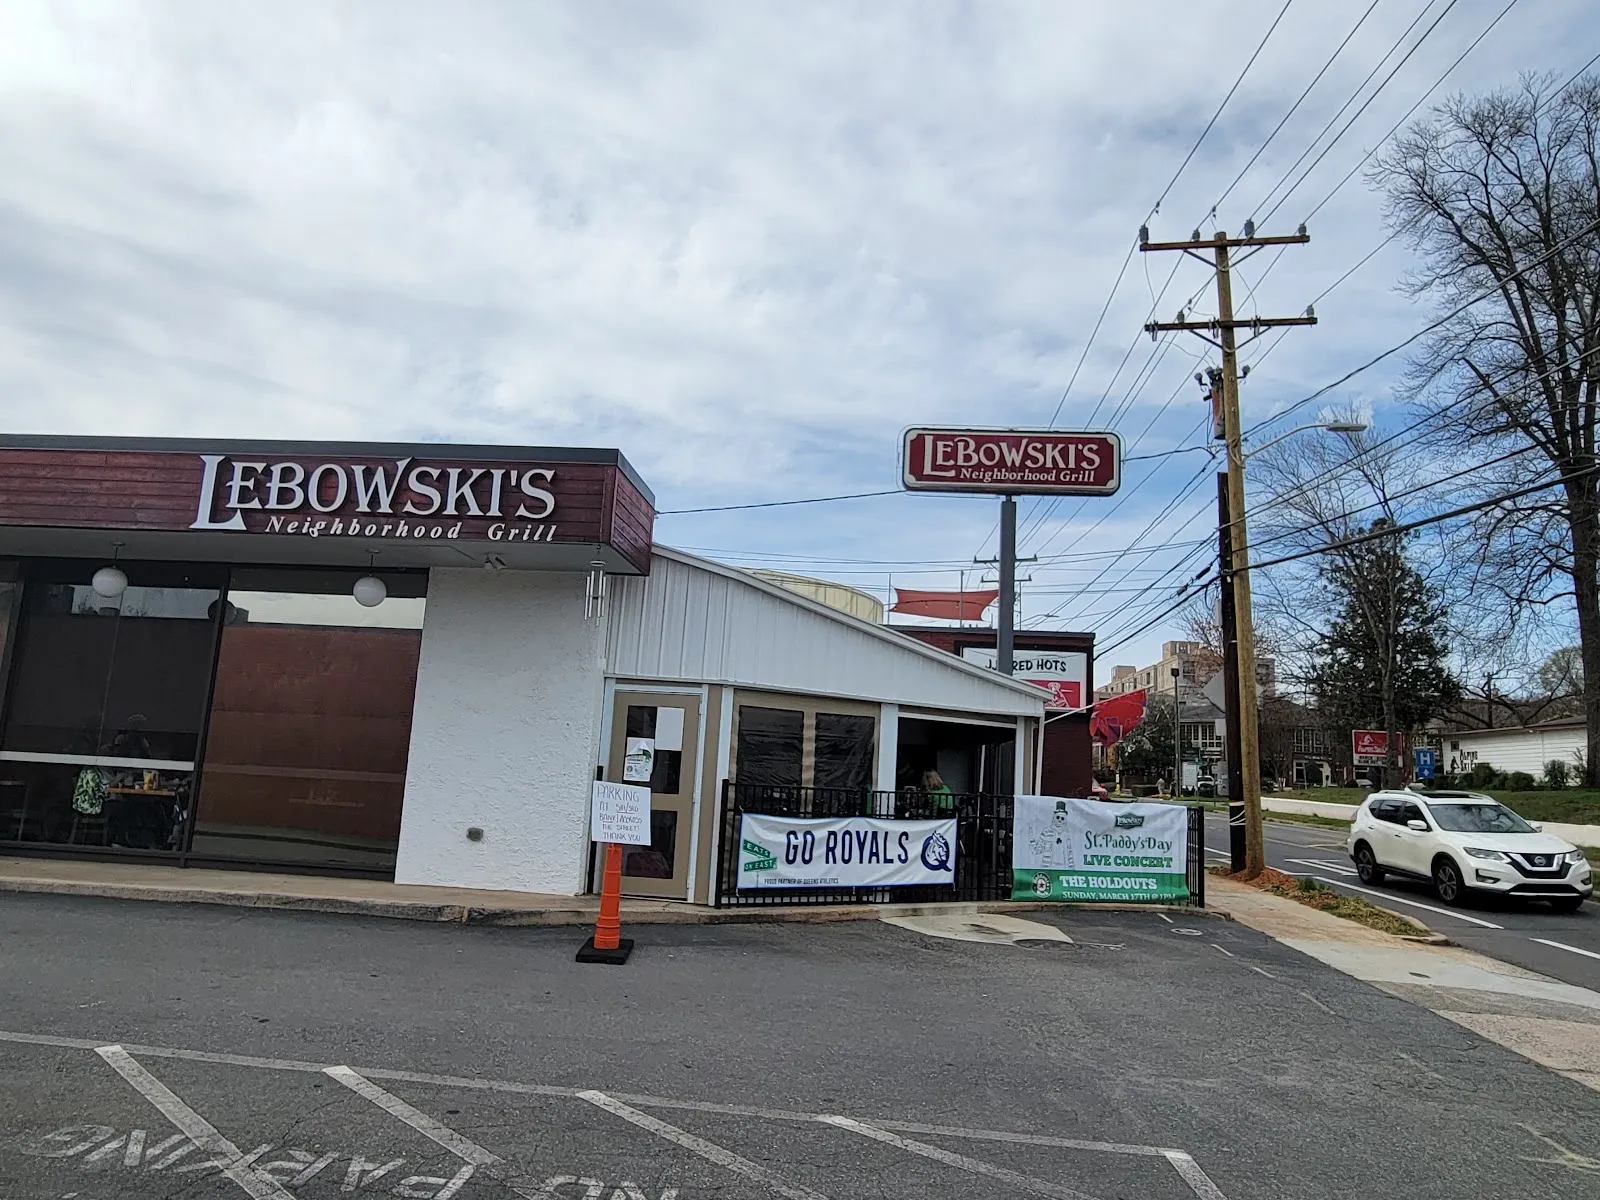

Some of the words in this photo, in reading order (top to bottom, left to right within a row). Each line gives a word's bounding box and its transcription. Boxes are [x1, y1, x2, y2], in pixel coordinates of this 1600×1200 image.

[923, 435, 1101, 477] LEBOWSKI'S
[960, 468, 1056, 483] Neighborhood
[1059, 470, 1095, 483] Grill
[188, 455, 557, 531] LEBOWSKI'S
[265, 515, 463, 539] Neighborhood
[486, 522, 558, 543] Grill
[1036, 659, 1067, 672] HOTS
[1419, 752, 1431, 765] H
[597, 783, 640, 802] PARKING
[599, 800, 609, 811] AT
[603, 832, 627, 841] THANK
[627, 834, 641, 842] YOU
[1084, 830, 1103, 850] St.
[1103, 833, 1144, 853] Paddy's
[1144, 837, 1172, 854] Day
[746, 842, 770, 856] EATS
[784, 830, 815, 865] GO
[824, 830, 910, 865] ROYALS
[744, 862, 754, 871] ON
[755, 860, 773, 870] EAST
[1083, 855, 1111, 867] LIVE
[1113, 855, 1173, 868] CONCERT
[1059, 875, 1087, 887] THE
[1089, 876, 1157, 890] HOLDOUTS
[1062, 891, 1098, 901] SUNDAY,
[1098, 892, 1130, 900] MARCH
[1130, 893, 1151, 901] 17TH
